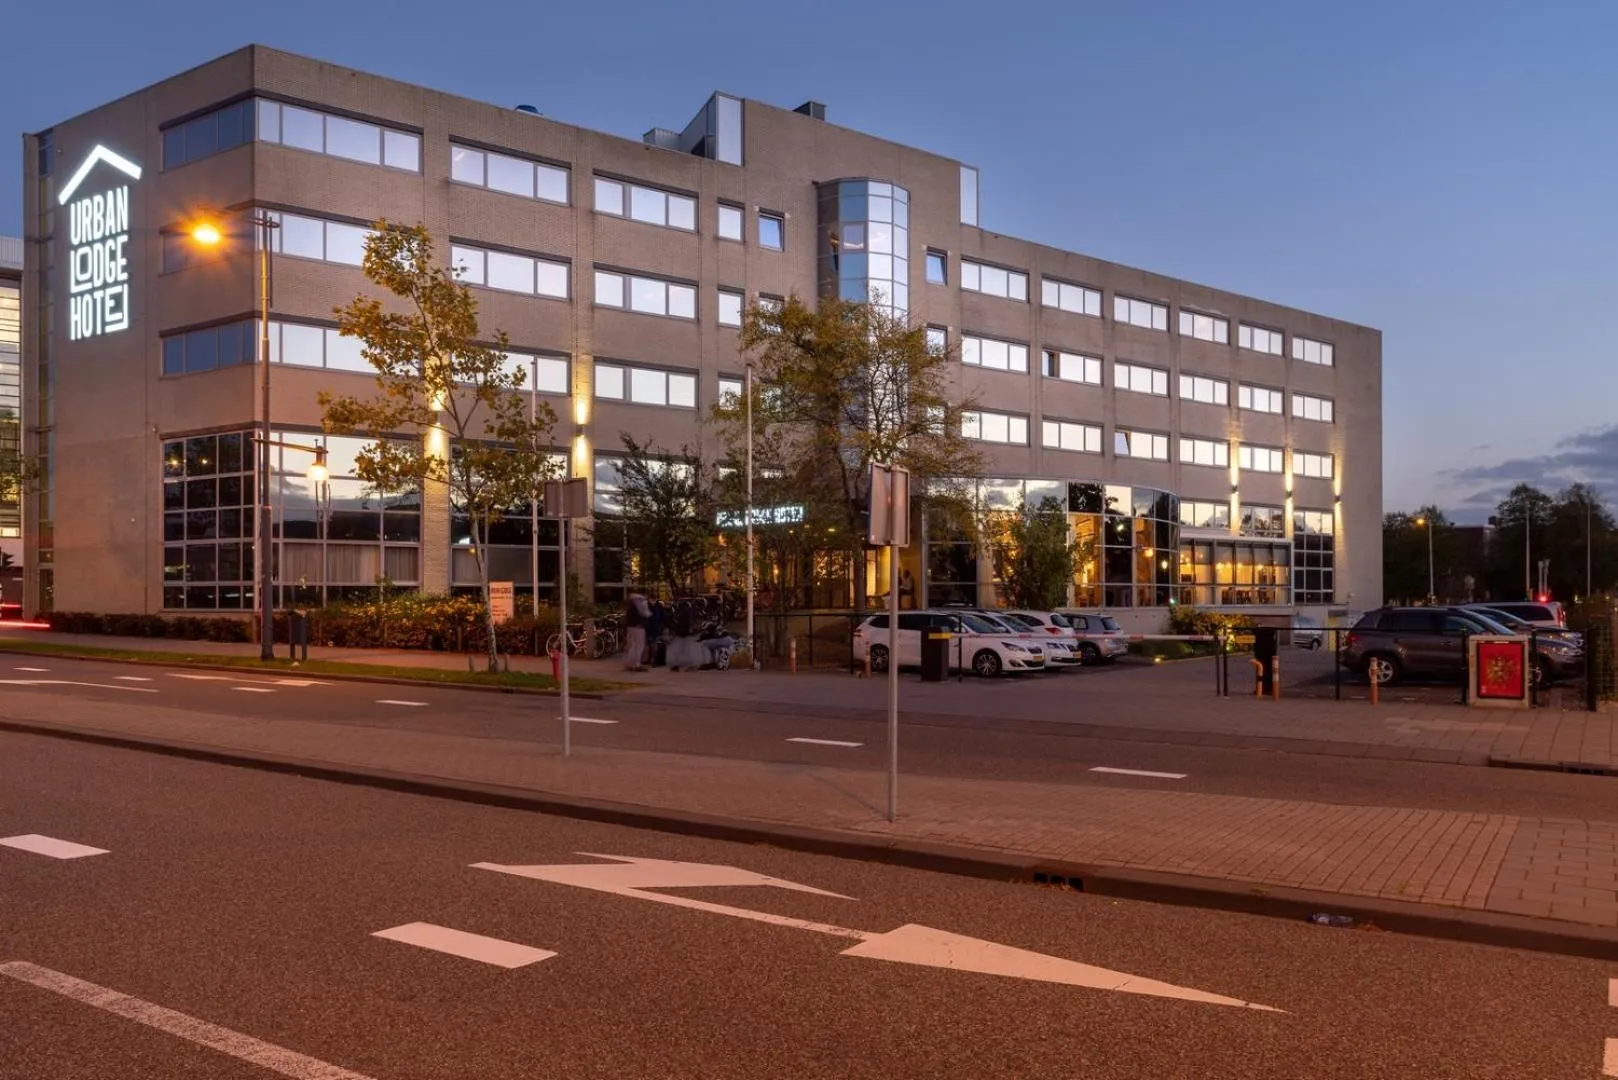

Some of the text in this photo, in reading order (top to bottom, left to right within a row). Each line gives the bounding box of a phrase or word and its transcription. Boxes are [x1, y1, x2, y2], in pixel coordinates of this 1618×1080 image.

[70, 185, 129, 246] URBAN
[70, 234, 129, 294] LODGE
[70, 283, 129, 341] HOTEL
